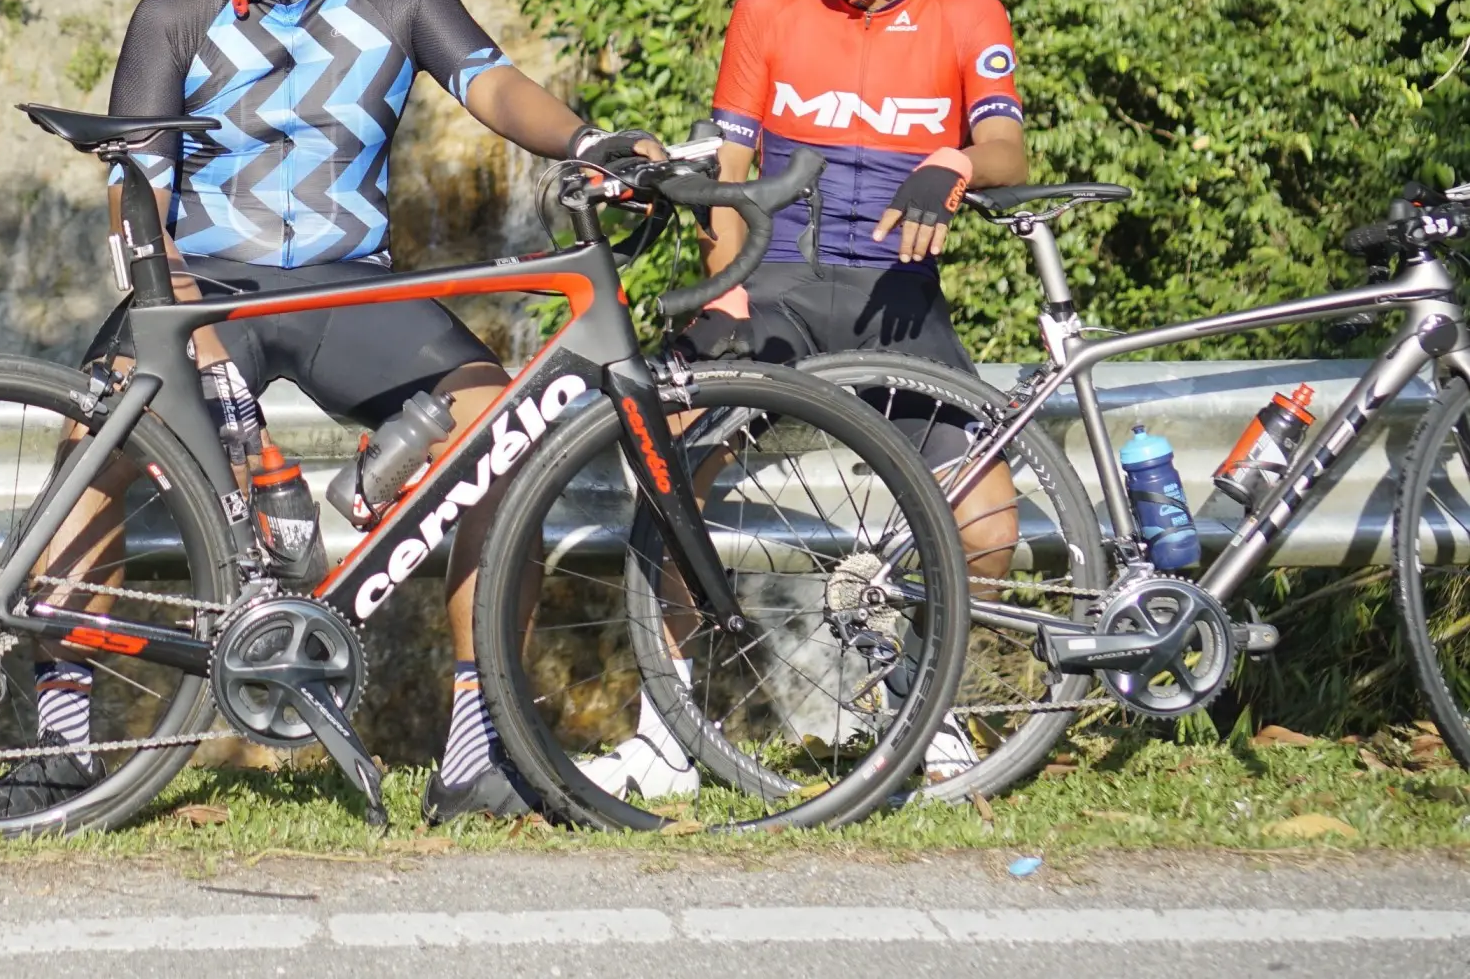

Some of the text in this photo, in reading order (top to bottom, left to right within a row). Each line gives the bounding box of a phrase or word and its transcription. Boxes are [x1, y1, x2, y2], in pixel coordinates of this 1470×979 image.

[772, 81, 952, 136] MNR
[604, 180, 620, 197] 3T
[621, 396, 671, 494] cervélo
[354, 374, 587, 620] cervélo
[301, 687, 351, 738] ULTEGRA
